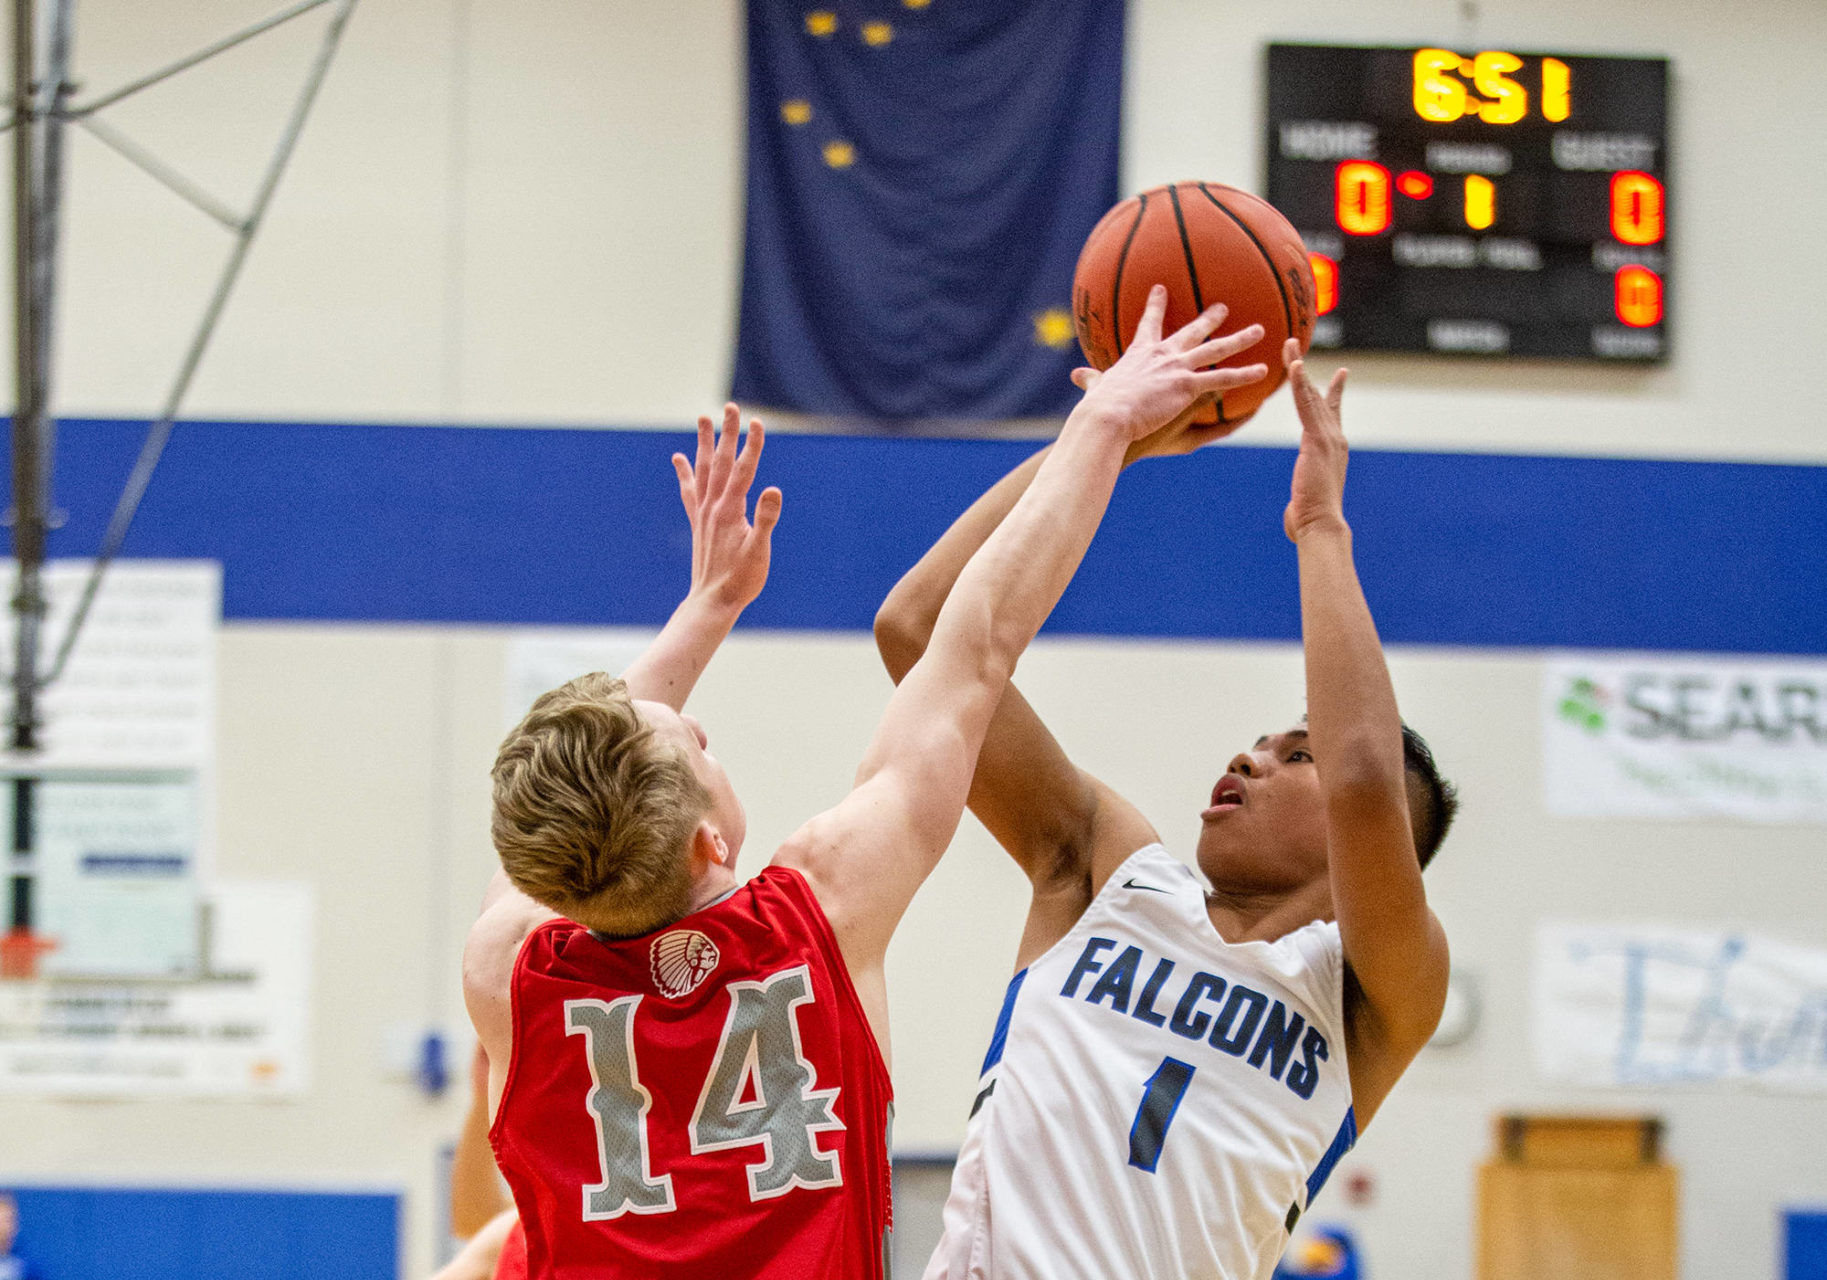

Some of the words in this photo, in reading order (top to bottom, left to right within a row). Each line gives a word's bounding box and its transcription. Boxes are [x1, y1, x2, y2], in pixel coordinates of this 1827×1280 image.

[1335, 159, 1391, 235] 0
[1464, 173, 1494, 230] 1
[1610, 169, 1664, 245] 0
[1060, 937, 1329, 1100] FALCONS
[564, 964, 847, 1222] 14
[1128, 1056, 1196, 1174] 1
